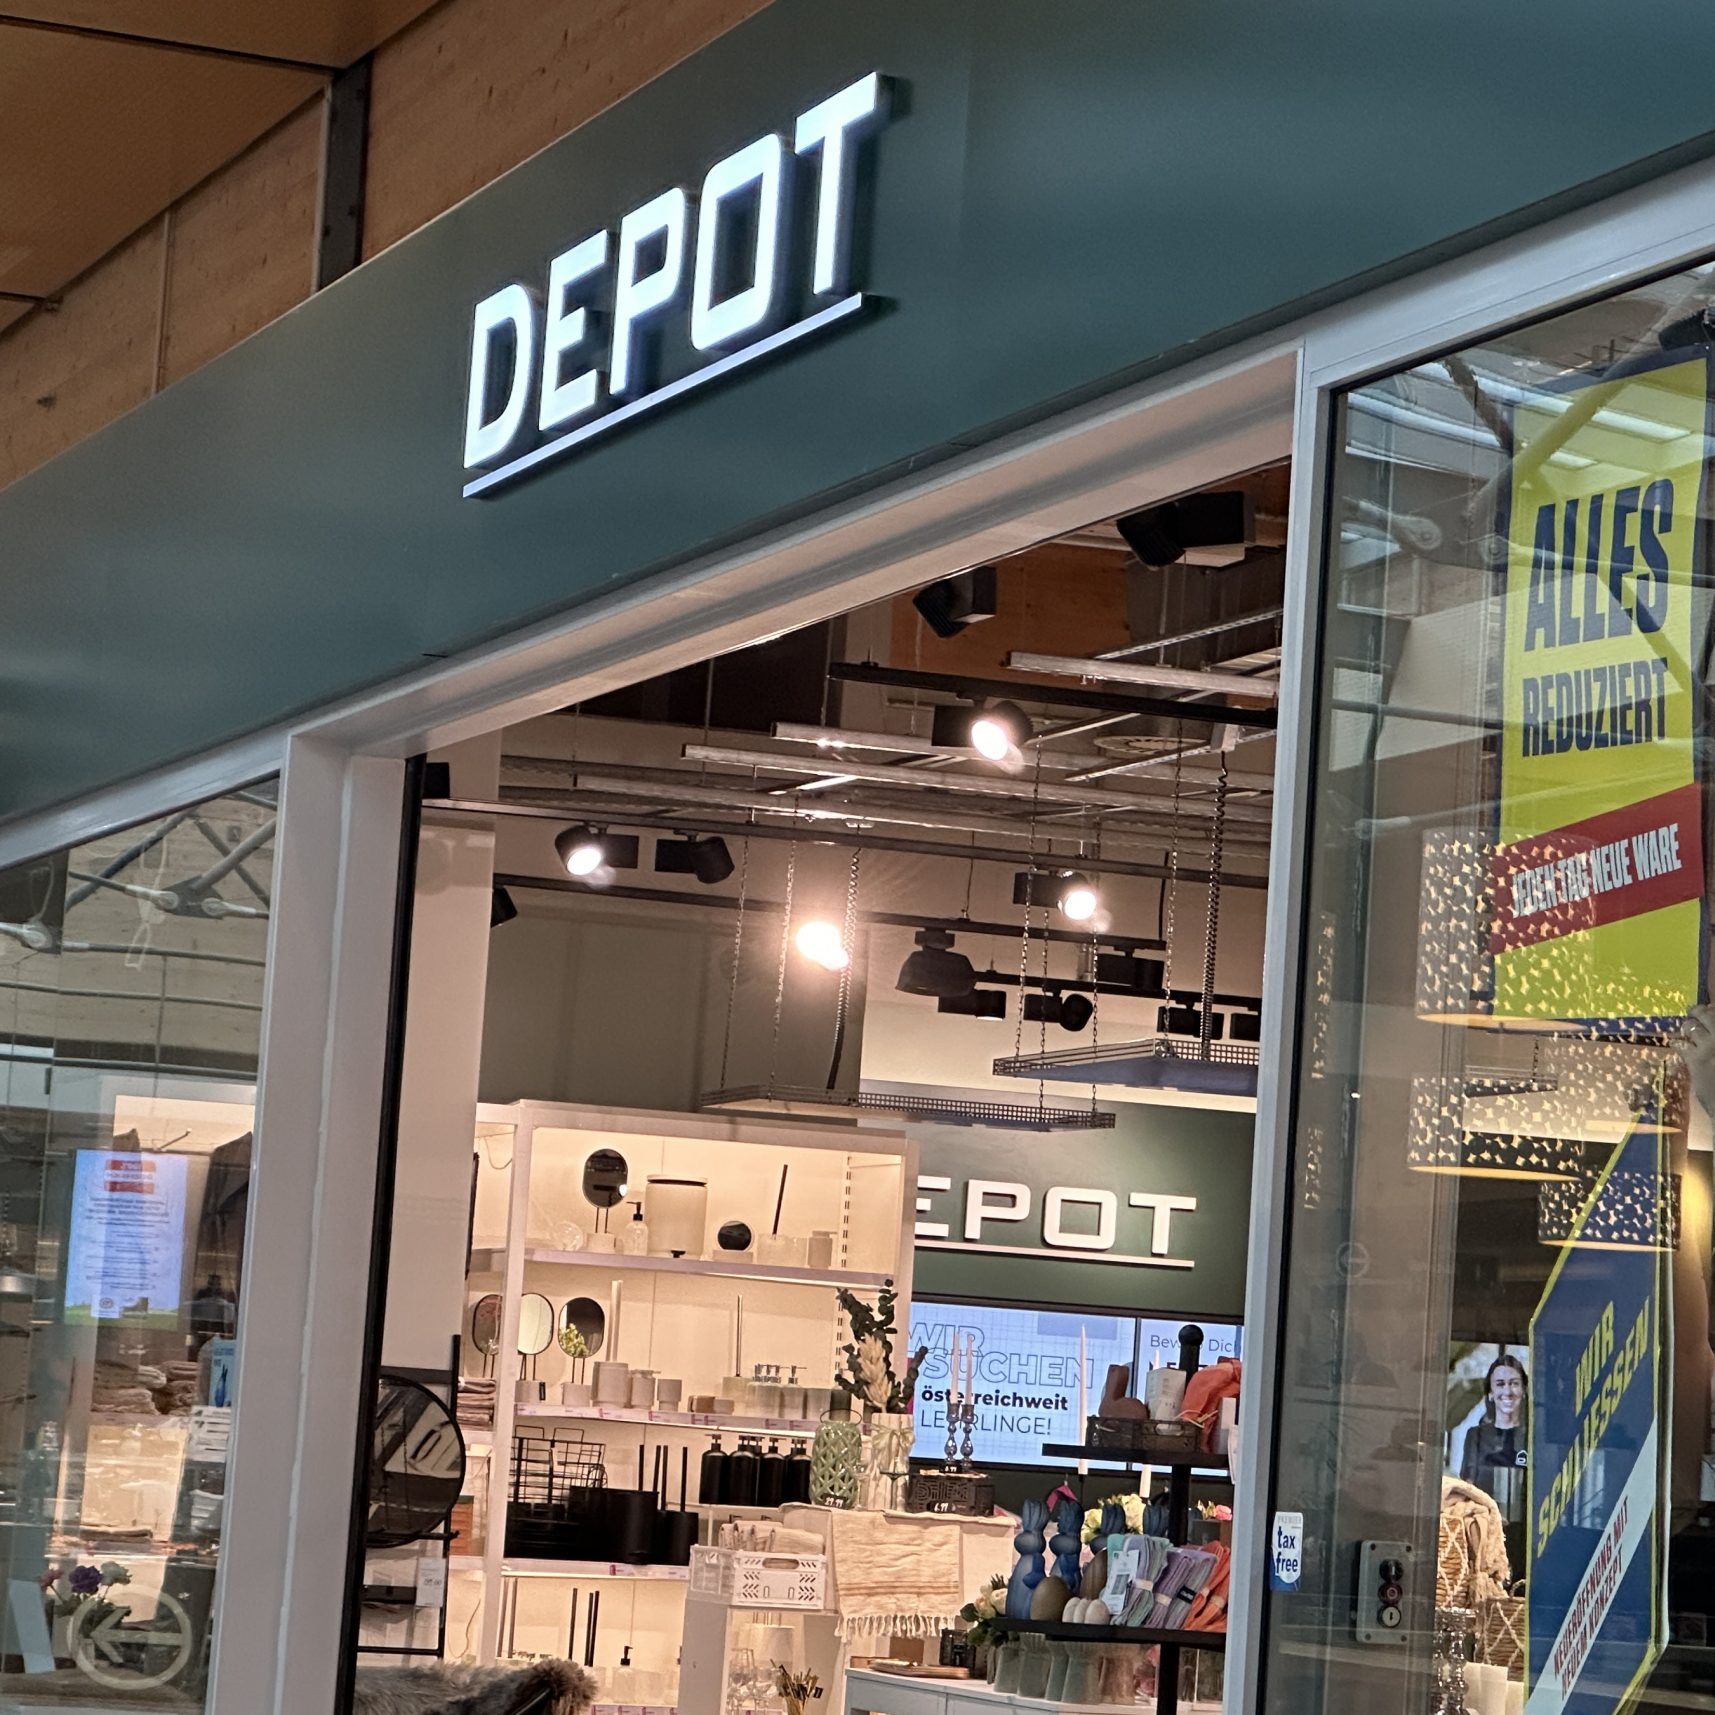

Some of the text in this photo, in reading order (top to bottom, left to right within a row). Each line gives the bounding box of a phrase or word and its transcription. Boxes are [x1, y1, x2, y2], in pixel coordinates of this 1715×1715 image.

[464, 71, 877, 470] DEPOT
[1524, 478, 1674, 652] ALLES
[1522, 657, 1668, 757] REDUZIERT
[1511, 823, 1682, 919] JEDEN TAG NEUE WARE
[914, 1175, 1197, 1254] EPOT
[908, 1322, 985, 1357] WIR
[923, 1347, 1094, 1389] SUCHEN
[1208, 1338, 1233, 1353] Dic
[1575, 1300, 1615, 1418] WIR
[921, 1385, 1068, 1411] östereichweit
[921, 1409, 1051, 1435] LERLINGE!
[1537, 1295, 1650, 1559] SCHLIESSEN
[1276, 1551, 1298, 1573] free
[1277, 1526, 1296, 1549] tax
[1553, 1495, 1629, 1681] NEUERÖFFNUNG MIT
[1588, 1543, 1623, 1641] KONZEPT
